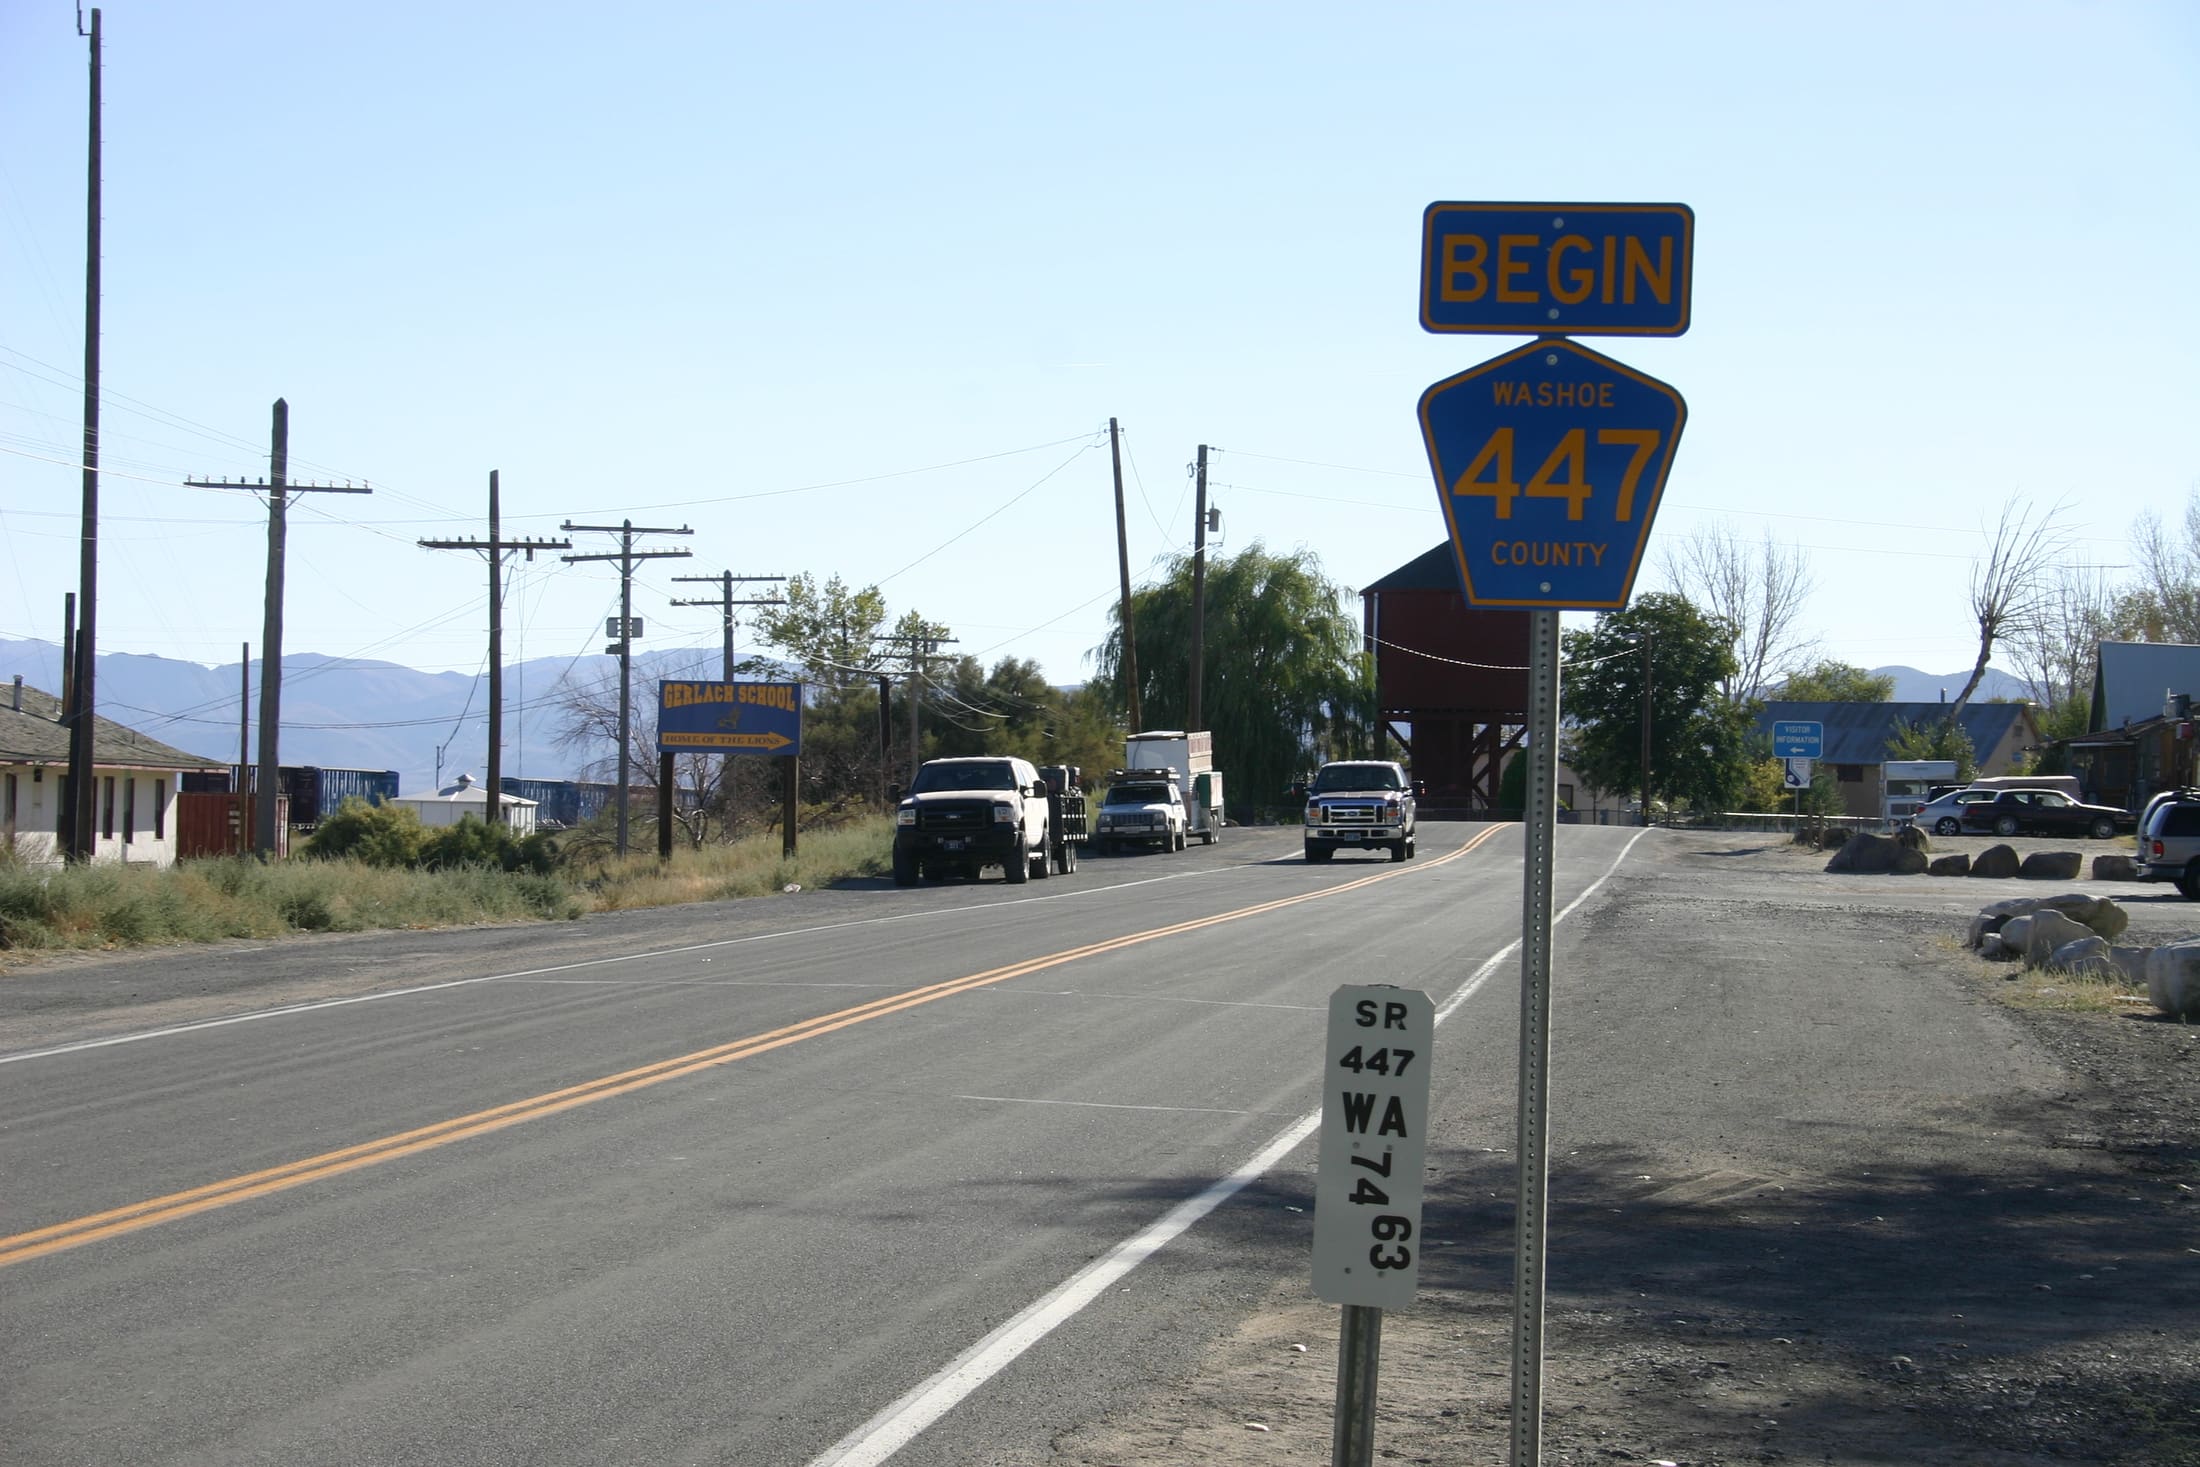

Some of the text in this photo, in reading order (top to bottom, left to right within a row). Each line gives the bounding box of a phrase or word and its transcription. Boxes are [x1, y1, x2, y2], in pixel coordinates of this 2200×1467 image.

[1440, 234, 1673, 305] BEGIN
[1493, 381, 1615, 407] WASHOE
[1453, 427, 1661, 522] 447
[1491, 541, 1608, 566] COUNTY
[664, 683, 795, 712] GERLACH SCHOOL
[665, 735, 781, 746] HOME OF THE LIONS
[1776, 736, 1820, 745] INFORMATION
[1784, 726, 1811, 734] VISITOR
[1355, 1000, 1408, 1030] SR
[1340, 1046, 1415, 1077] 447
[1342, 1092, 1408, 1138] WA
